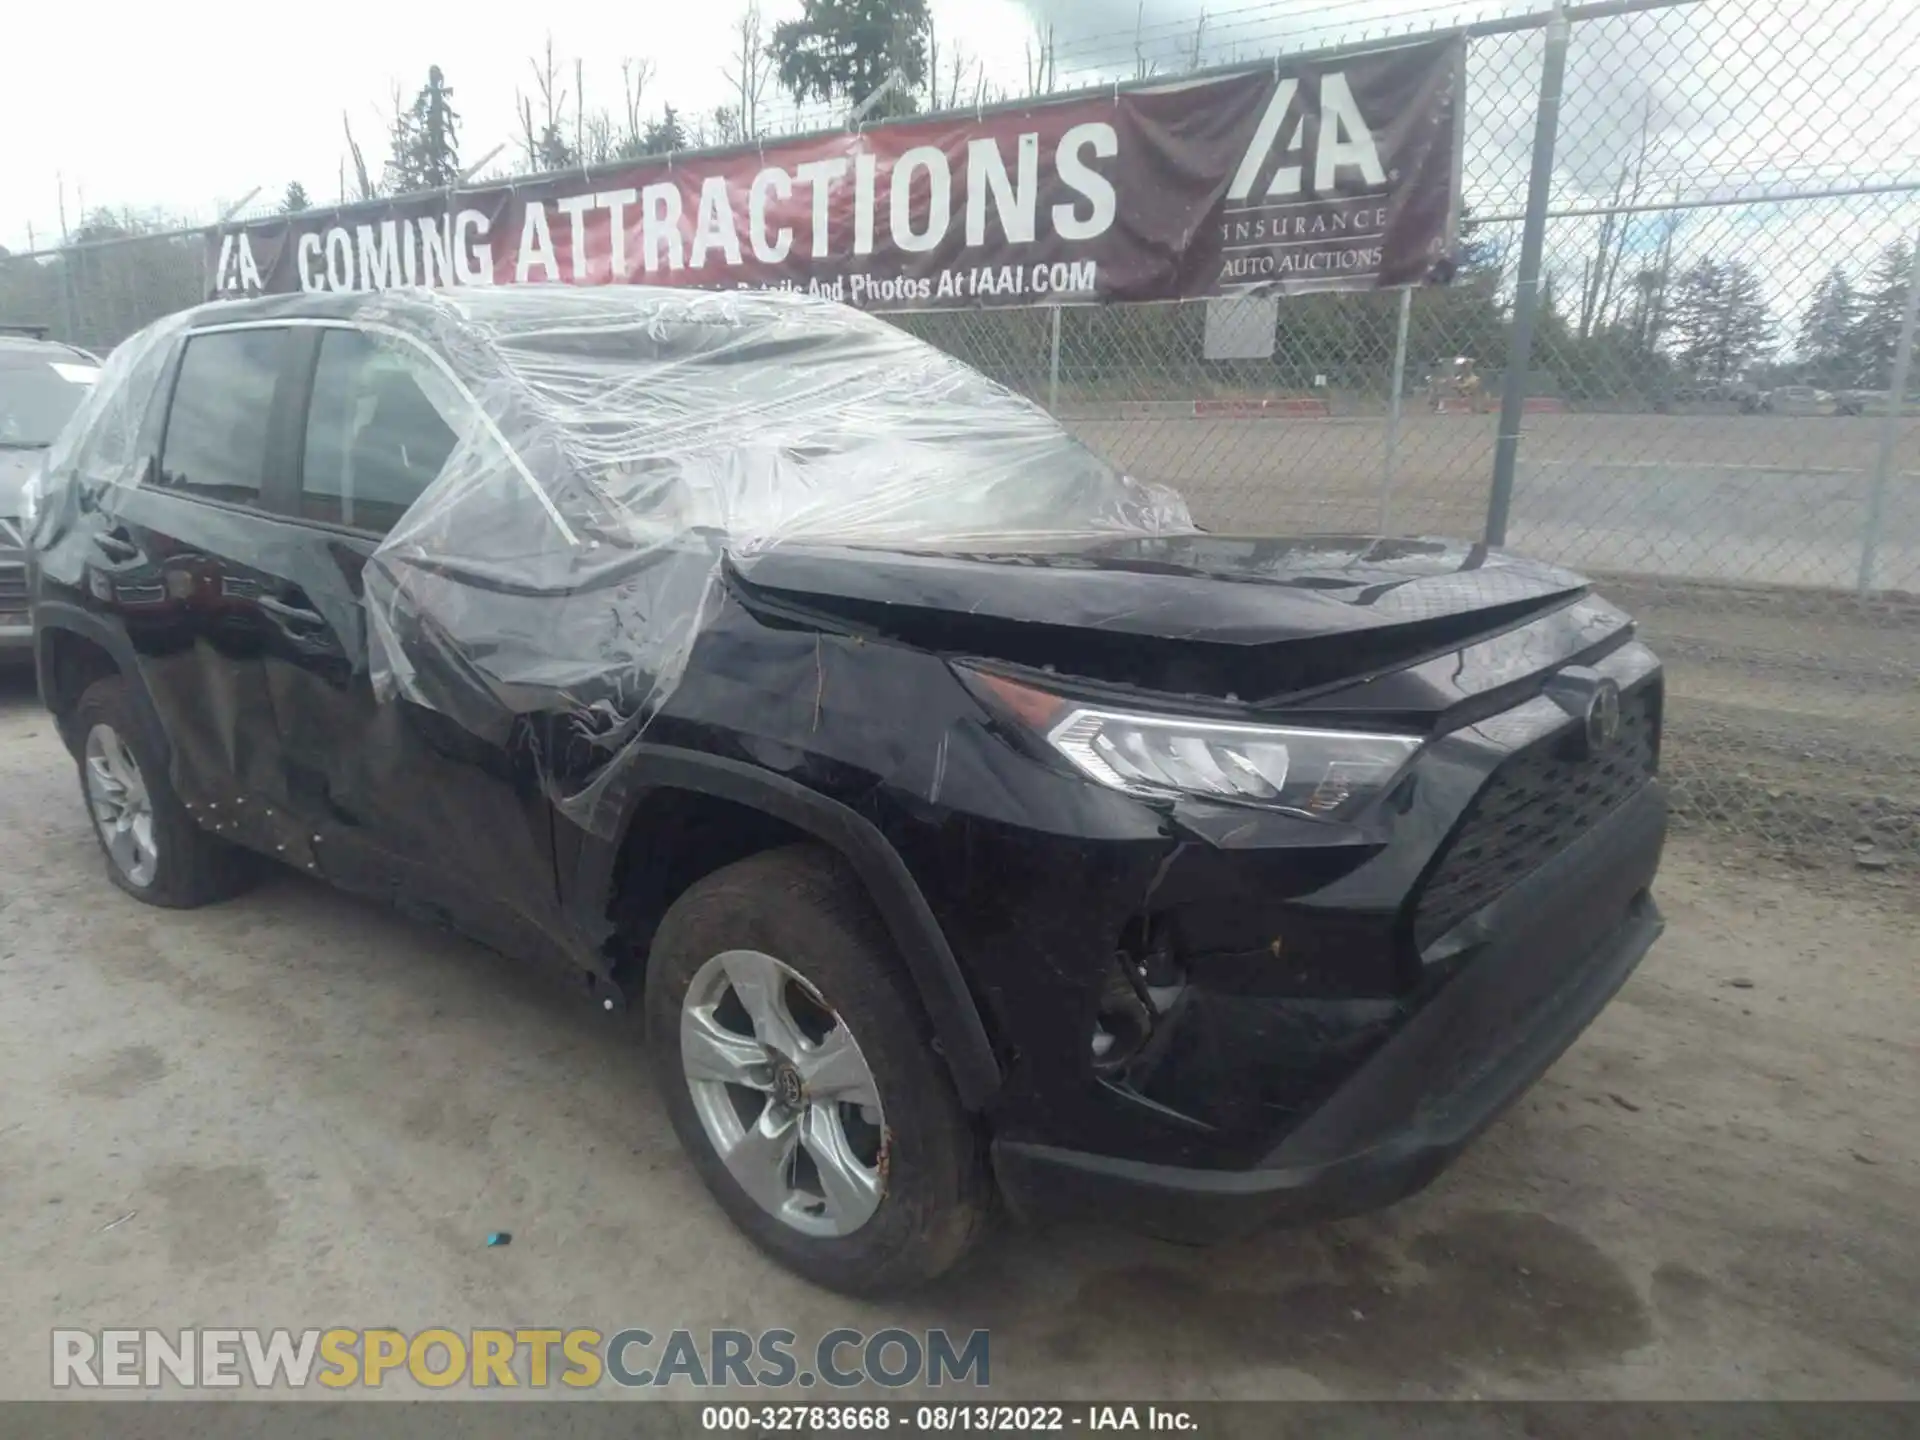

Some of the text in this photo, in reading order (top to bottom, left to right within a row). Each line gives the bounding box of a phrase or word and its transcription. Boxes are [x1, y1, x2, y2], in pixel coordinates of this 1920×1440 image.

[298, 122, 1119, 294] COMING ATTRACTIONS
[1222, 207, 1388, 241] INSURANCE
[809, 276, 844, 300] And
[850, 273, 931, 300] Photos
[937, 268, 963, 297] At
[969, 260, 1097, 296] IAAI.COM
[1220, 247, 1384, 277] AUTO AUCTIONS
